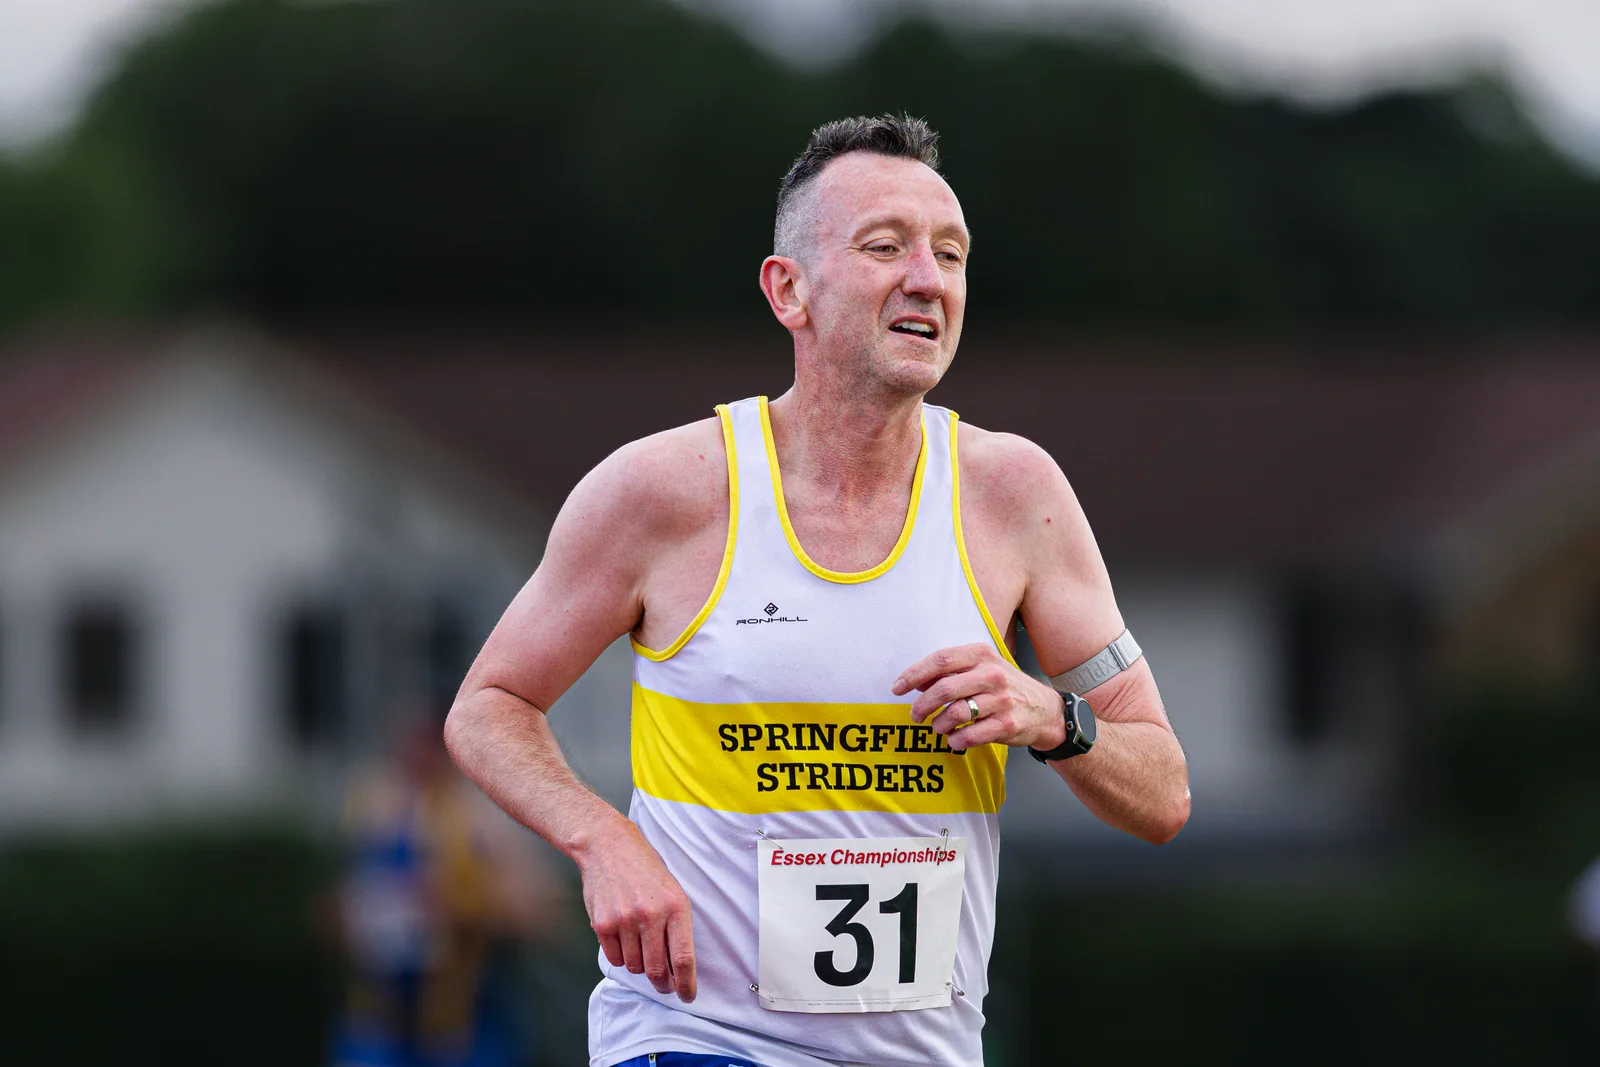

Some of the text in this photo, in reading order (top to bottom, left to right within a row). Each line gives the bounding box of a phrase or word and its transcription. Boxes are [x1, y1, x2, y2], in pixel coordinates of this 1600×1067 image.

[736, 616, 808, 625] RONHILL
[718, 723, 967, 755] SPRINGFIEL
[757, 762, 944, 793] STRIDERS
[771, 848, 957, 868] Essex Championships
[813, 882, 918, 987] 31
